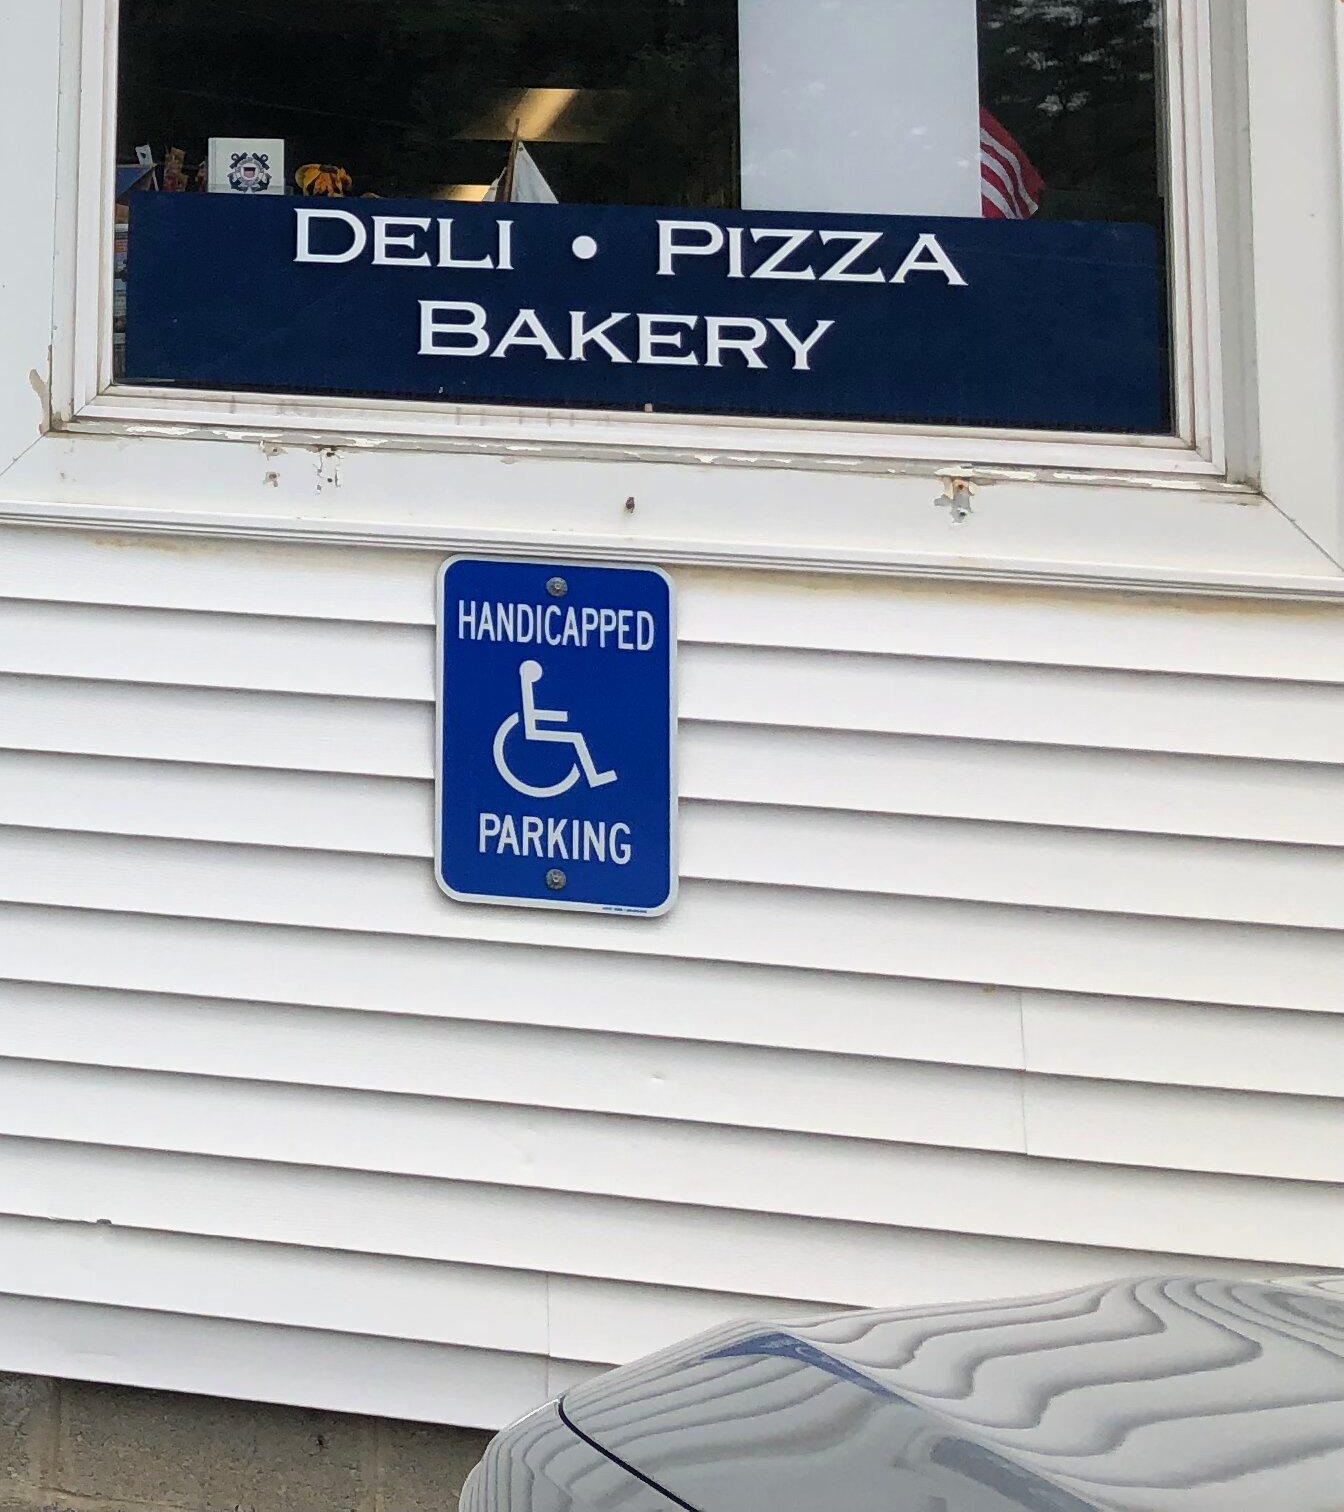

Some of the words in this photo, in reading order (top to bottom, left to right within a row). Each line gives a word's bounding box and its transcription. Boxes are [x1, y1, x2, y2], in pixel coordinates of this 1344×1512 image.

[291, 206, 516, 271] DELI
[654, 218, 970, 287] PIZZA
[416, 298, 837, 372] BAKERY
[457, 599, 656, 652] HANDICAPPED
[478, 812, 633, 866] PARKING
